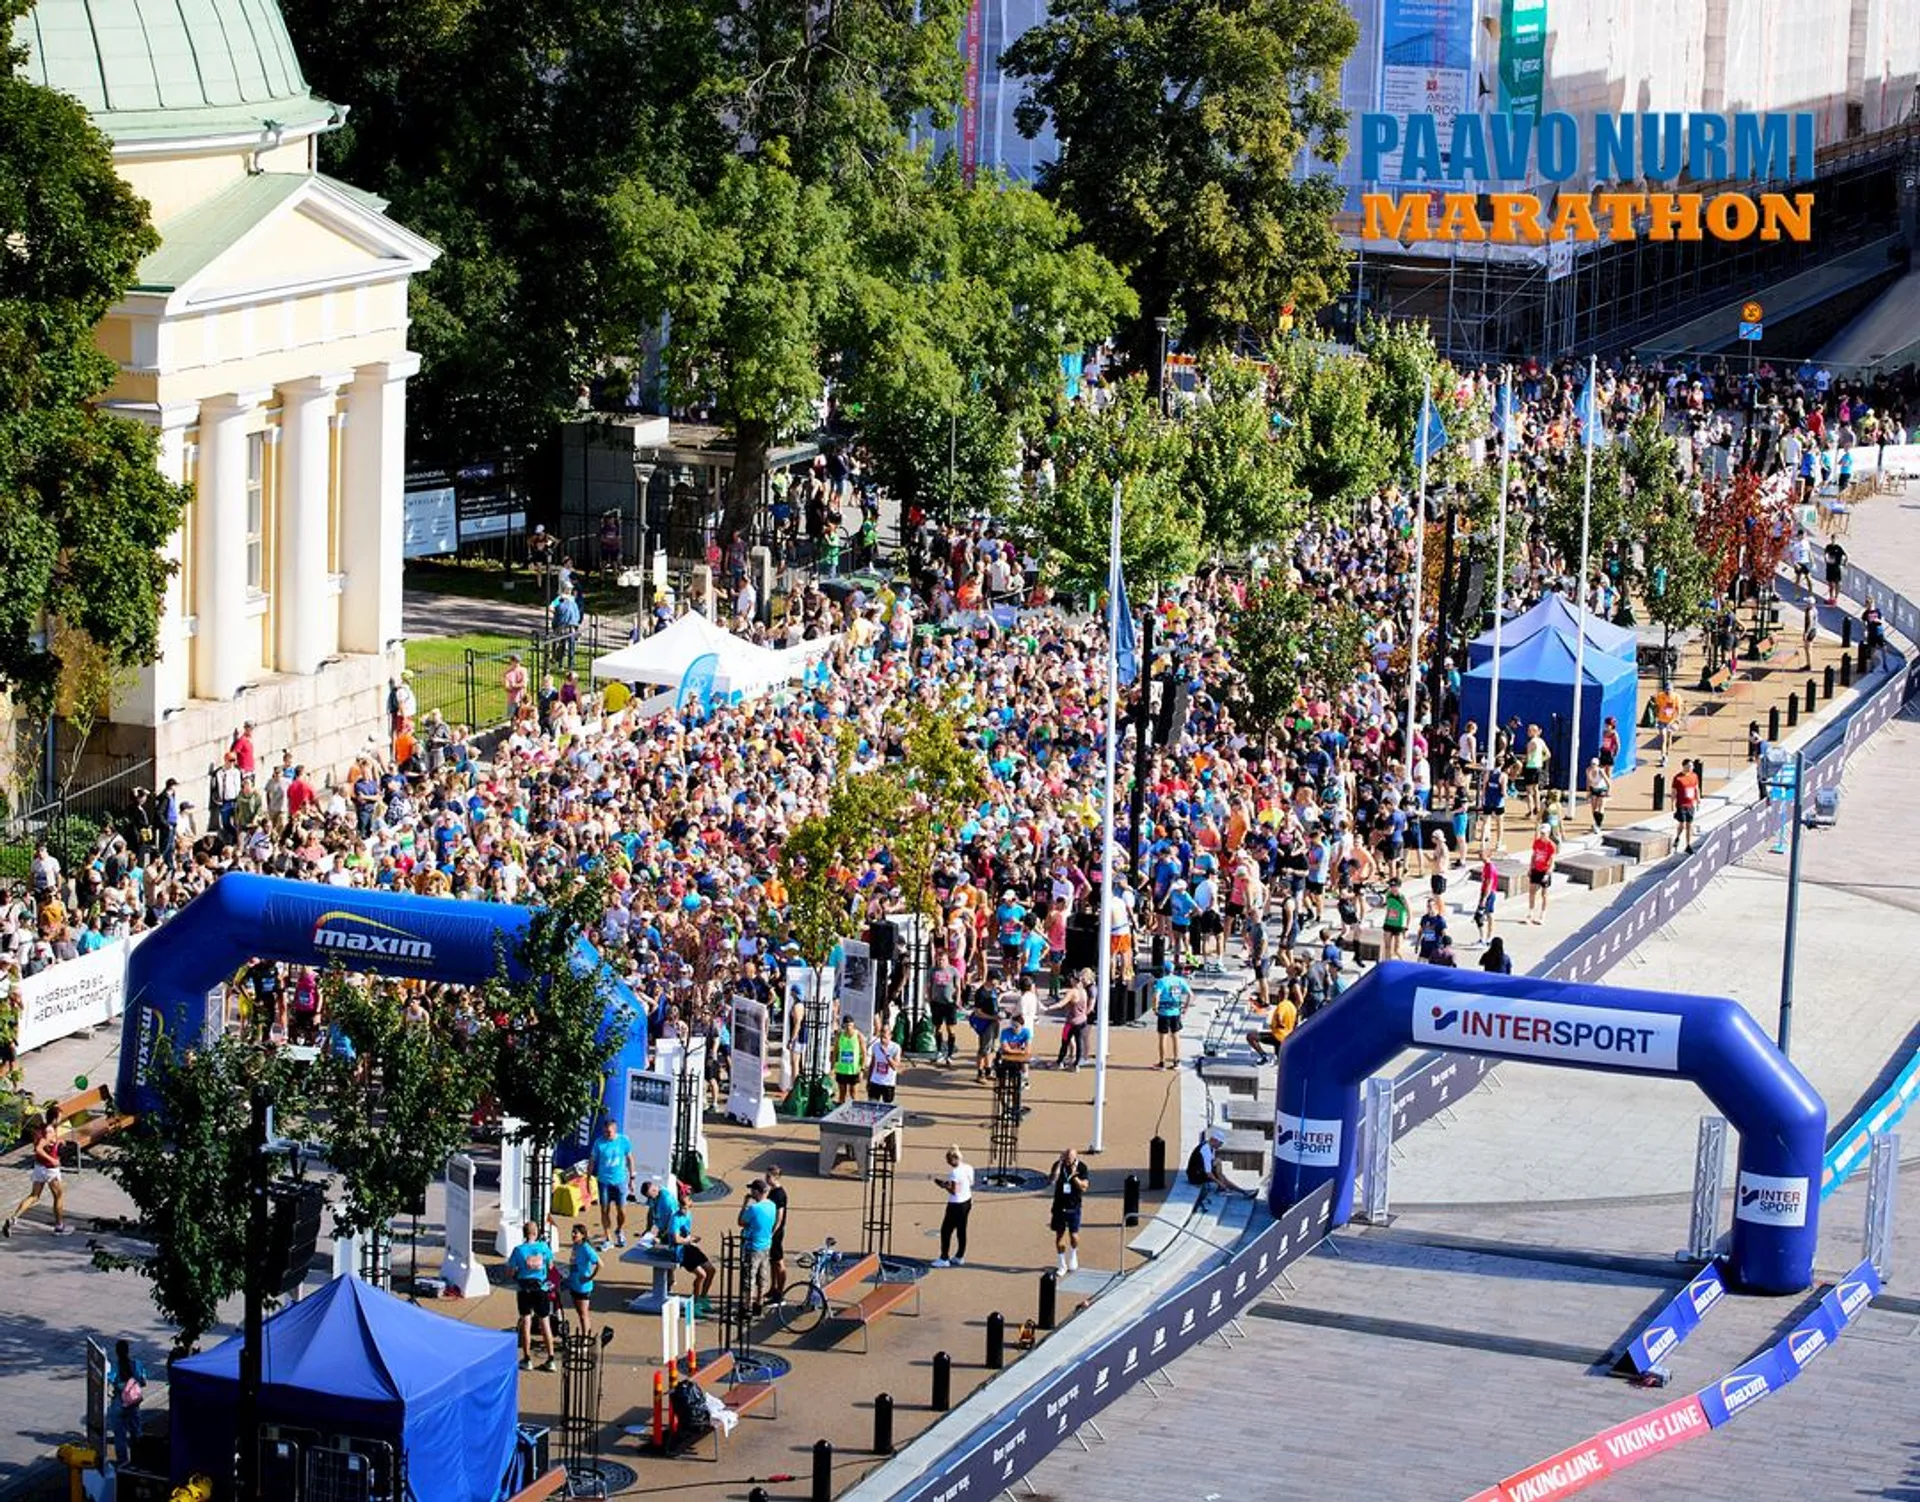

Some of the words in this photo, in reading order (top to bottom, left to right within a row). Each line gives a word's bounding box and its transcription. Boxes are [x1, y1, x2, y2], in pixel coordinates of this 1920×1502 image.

[313, 928, 431, 958] maxim
[1462, 1009, 1654, 1054] INTERSPORT
[1294, 1130, 1334, 1144] INTER
[1294, 1141, 1332, 1153] SPORT
[1759, 1201, 1800, 1213] SPORT
[1761, 1188, 1801, 1203] INTER
[1725, 1375, 1768, 1411] maxim
[1606, 1419, 1667, 1459] VIKING
[1666, 1404, 1702, 1435] LINE
[1508, 1465, 1568, 1502] VIKING
[1567, 1449, 1604, 1481] LINE
